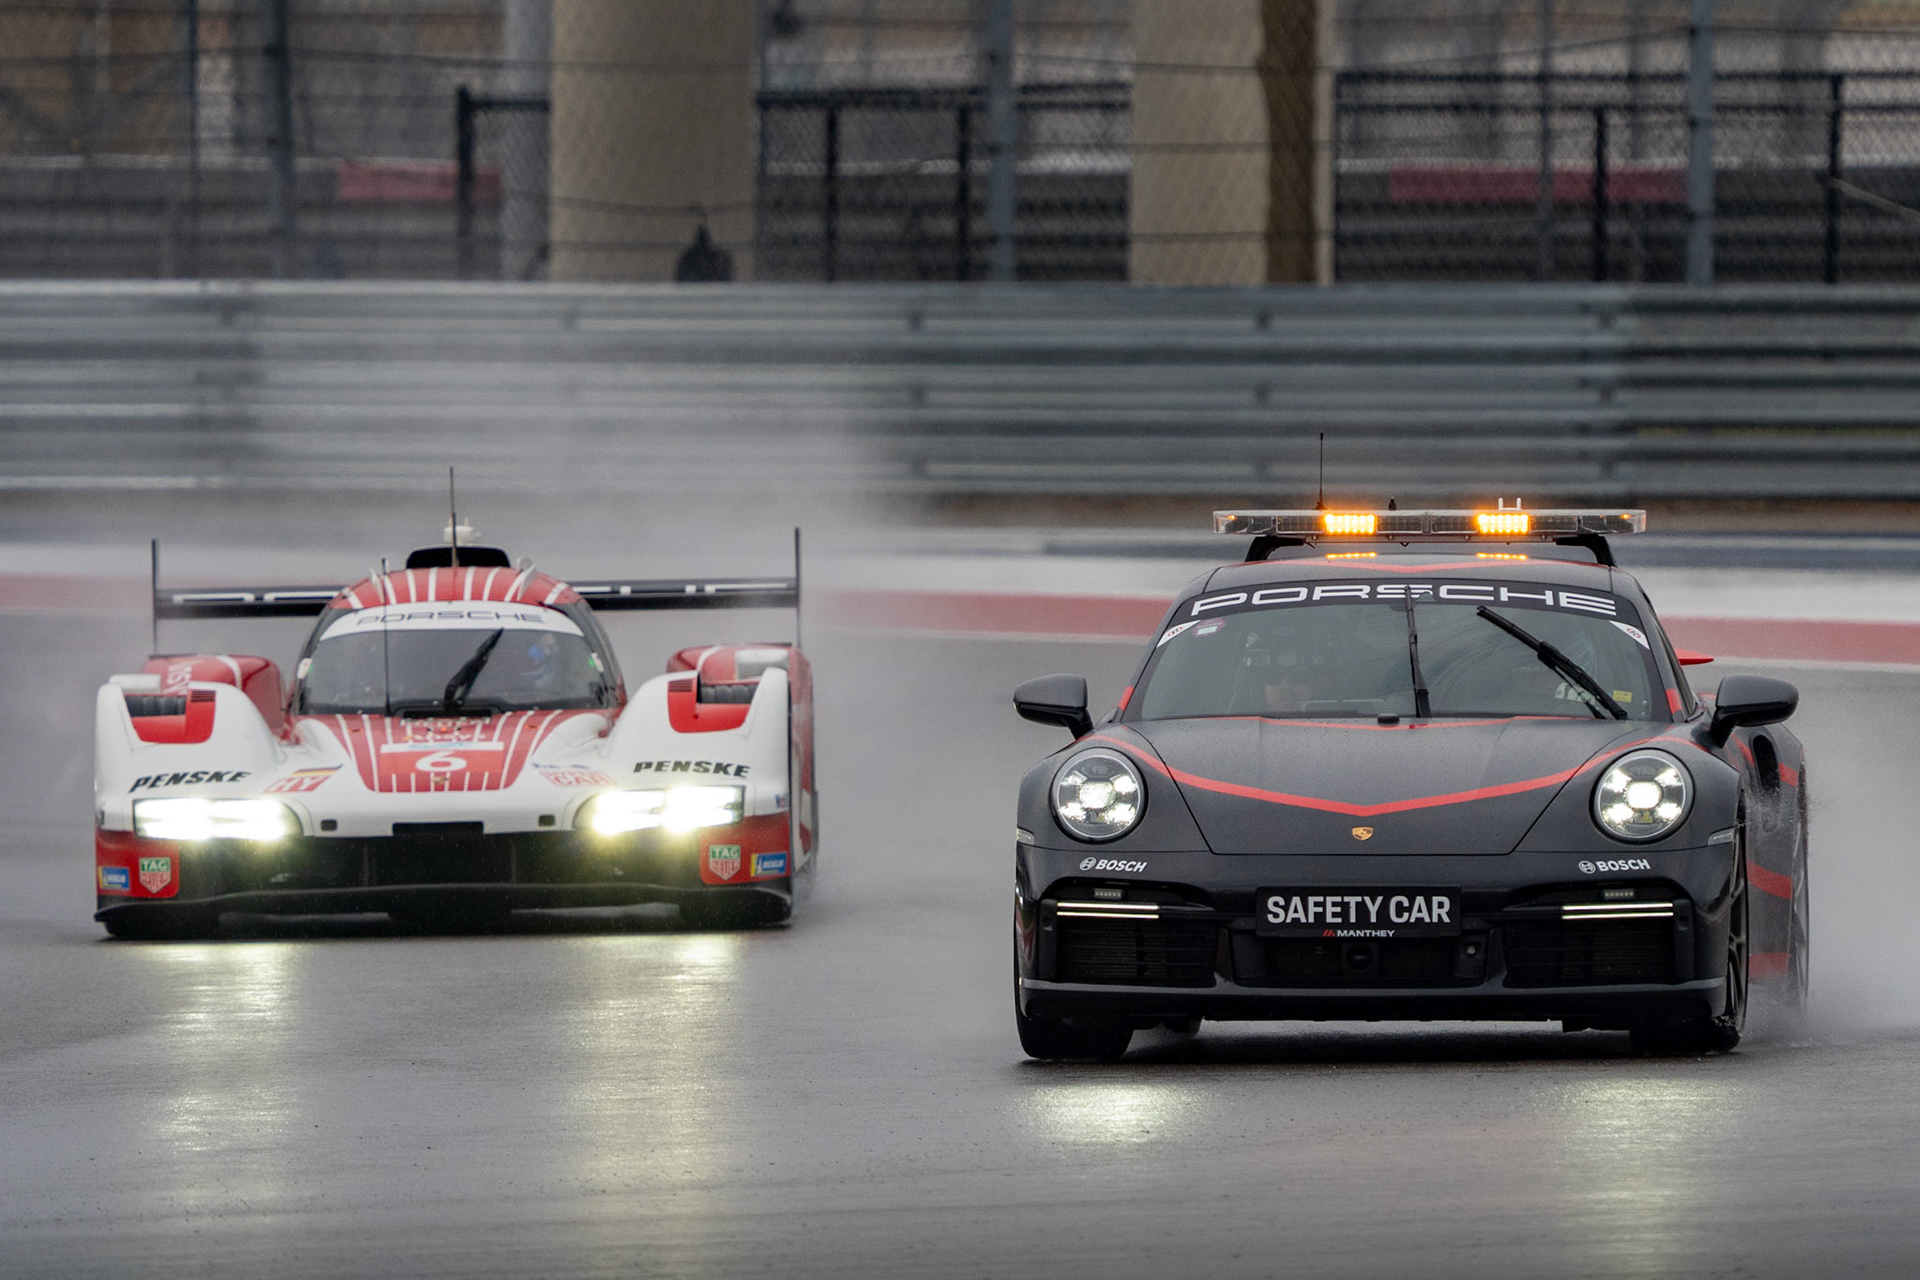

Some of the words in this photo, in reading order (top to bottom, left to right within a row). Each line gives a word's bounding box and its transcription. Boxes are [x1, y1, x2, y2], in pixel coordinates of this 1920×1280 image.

[1190, 584, 1617, 617] PORSCHE
[356, 610, 546, 626] PORSCHE
[415, 750, 467, 772] 6
[633, 760, 751, 779] PENSKE
[128, 770, 252, 794] PENSKE
[711, 847, 738, 858] TAG
[142, 859, 169, 871] TAG
[1095, 859, 1148, 872] BOSCH
[1596, 859, 1651, 872] BOSCH
[1267, 896, 1384, 924] SAFETY
[1389, 896, 1451, 924] CAR
[1337, 929, 1395, 937] MANTHEY
